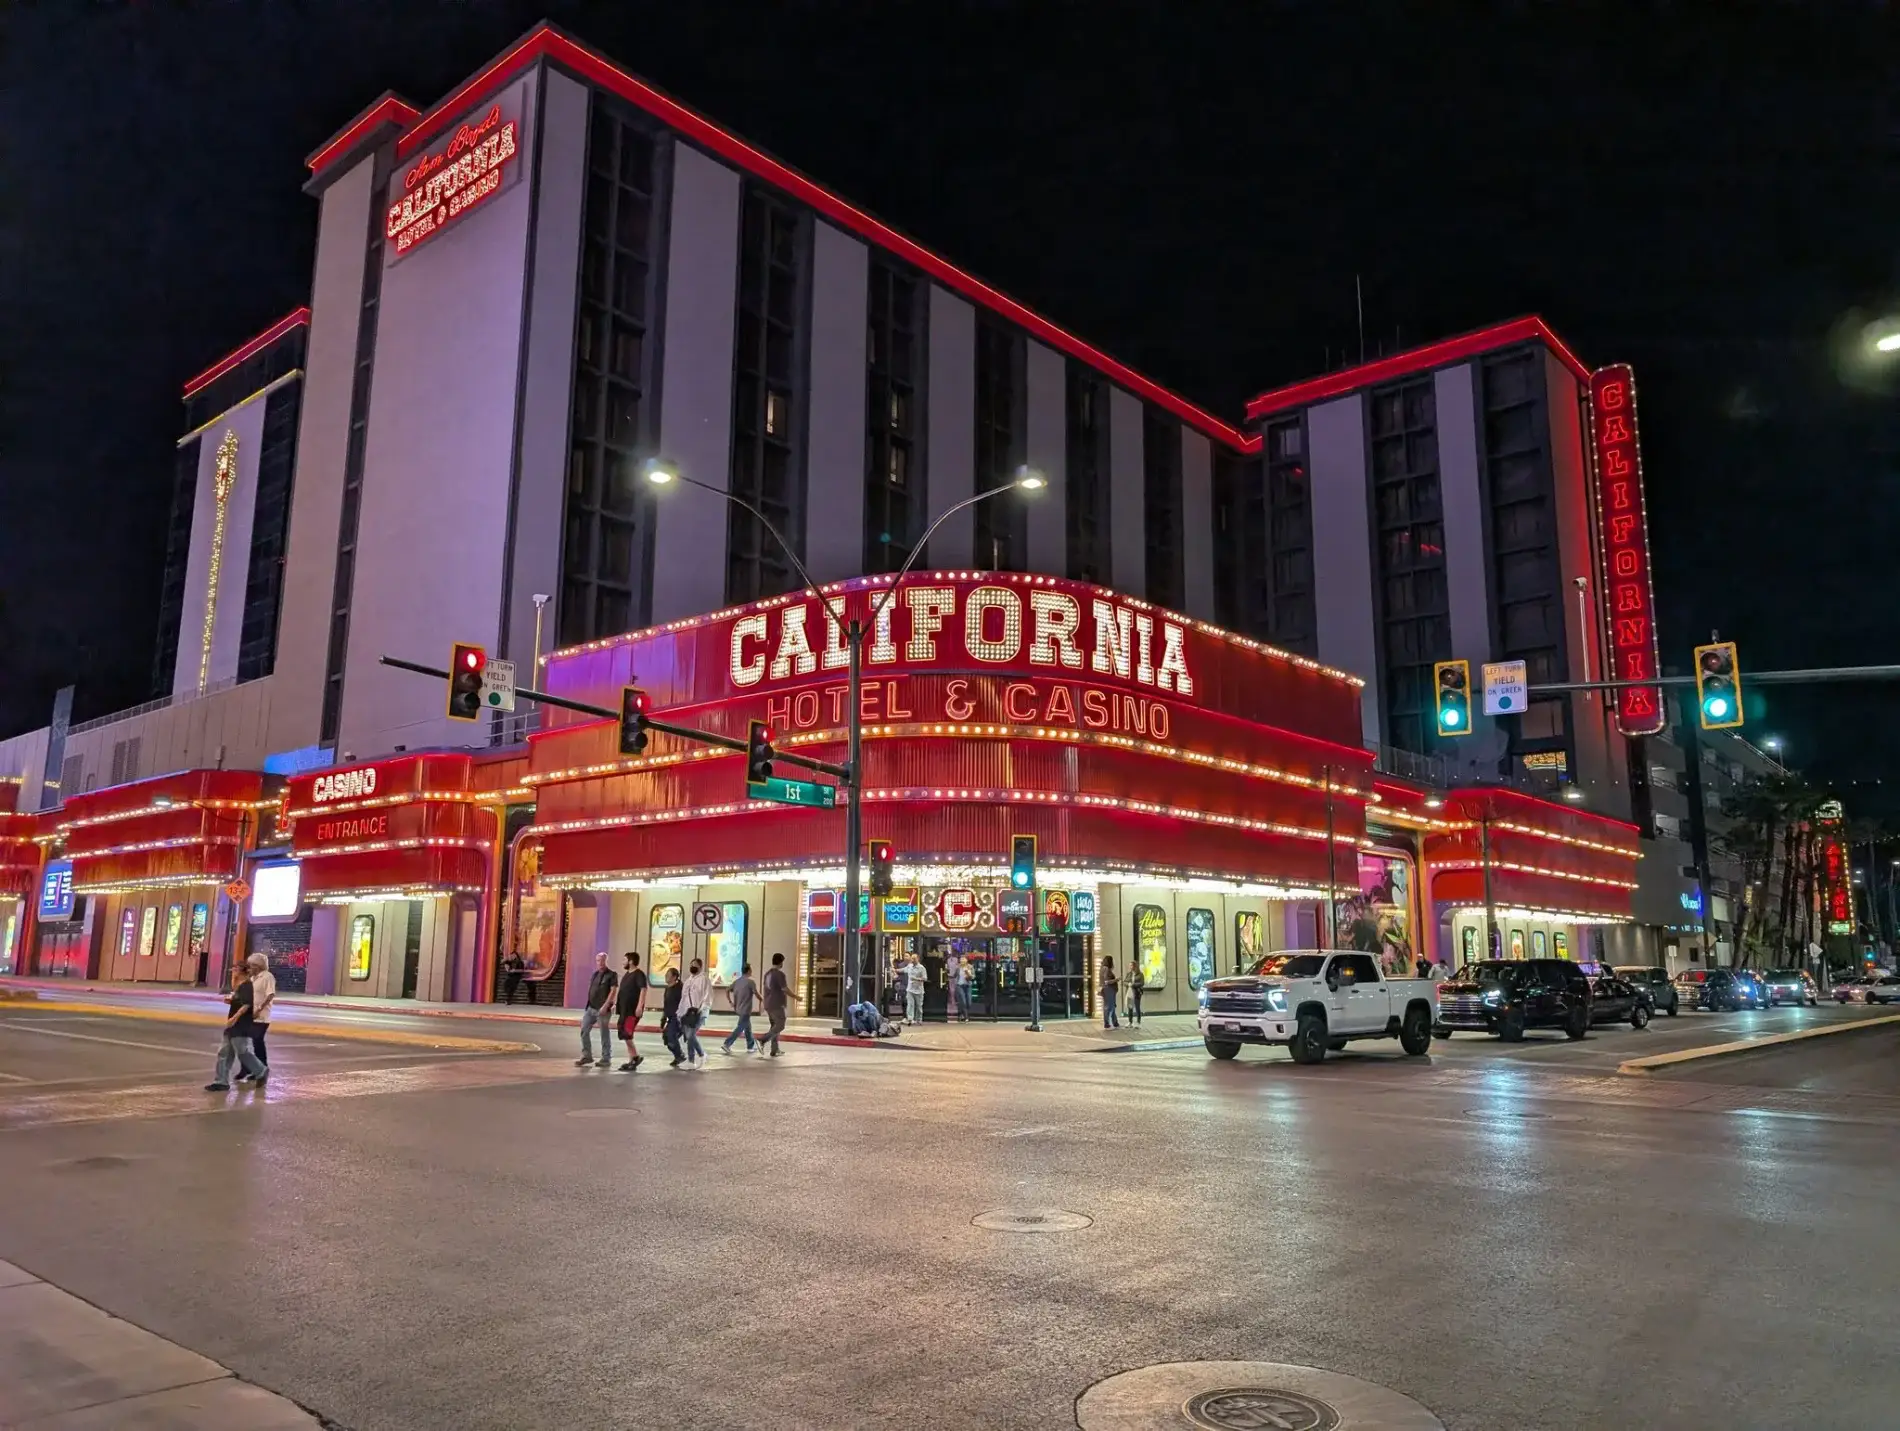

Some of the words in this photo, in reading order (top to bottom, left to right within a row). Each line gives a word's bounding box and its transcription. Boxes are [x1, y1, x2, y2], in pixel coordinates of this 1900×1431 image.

[387, 121, 516, 238] CALIFORNIA
[397, 212, 436, 252] HOTEL
[449, 168, 500, 217] CASINO
[1602, 383, 1652, 716] CALIFORNIA
[730, 585, 1194, 697] CALIFORNIA
[486, 671, 506, 681] YIELD
[497, 663, 512, 671] TURN
[1486, 667, 1501, 676] LEFT
[1505, 664, 1522, 672] TURN
[492, 683, 511, 692] GREEN
[1494, 676, 1515, 685] YIELD
[1501, 686, 1522, 694] GREEN
[767, 680, 912, 732] HOTEL
[946, 679, 974, 720] &
[1004, 683, 1170, 740] CASINO
[313, 768, 376, 802] CASINO
[785, 783, 801, 801] 1st
[318, 816, 387, 840] ENTRANCE
[884, 904, 918, 913] NOODLE
[943, 890, 972, 928] C
[1001, 905, 1028, 913] SPORTS
